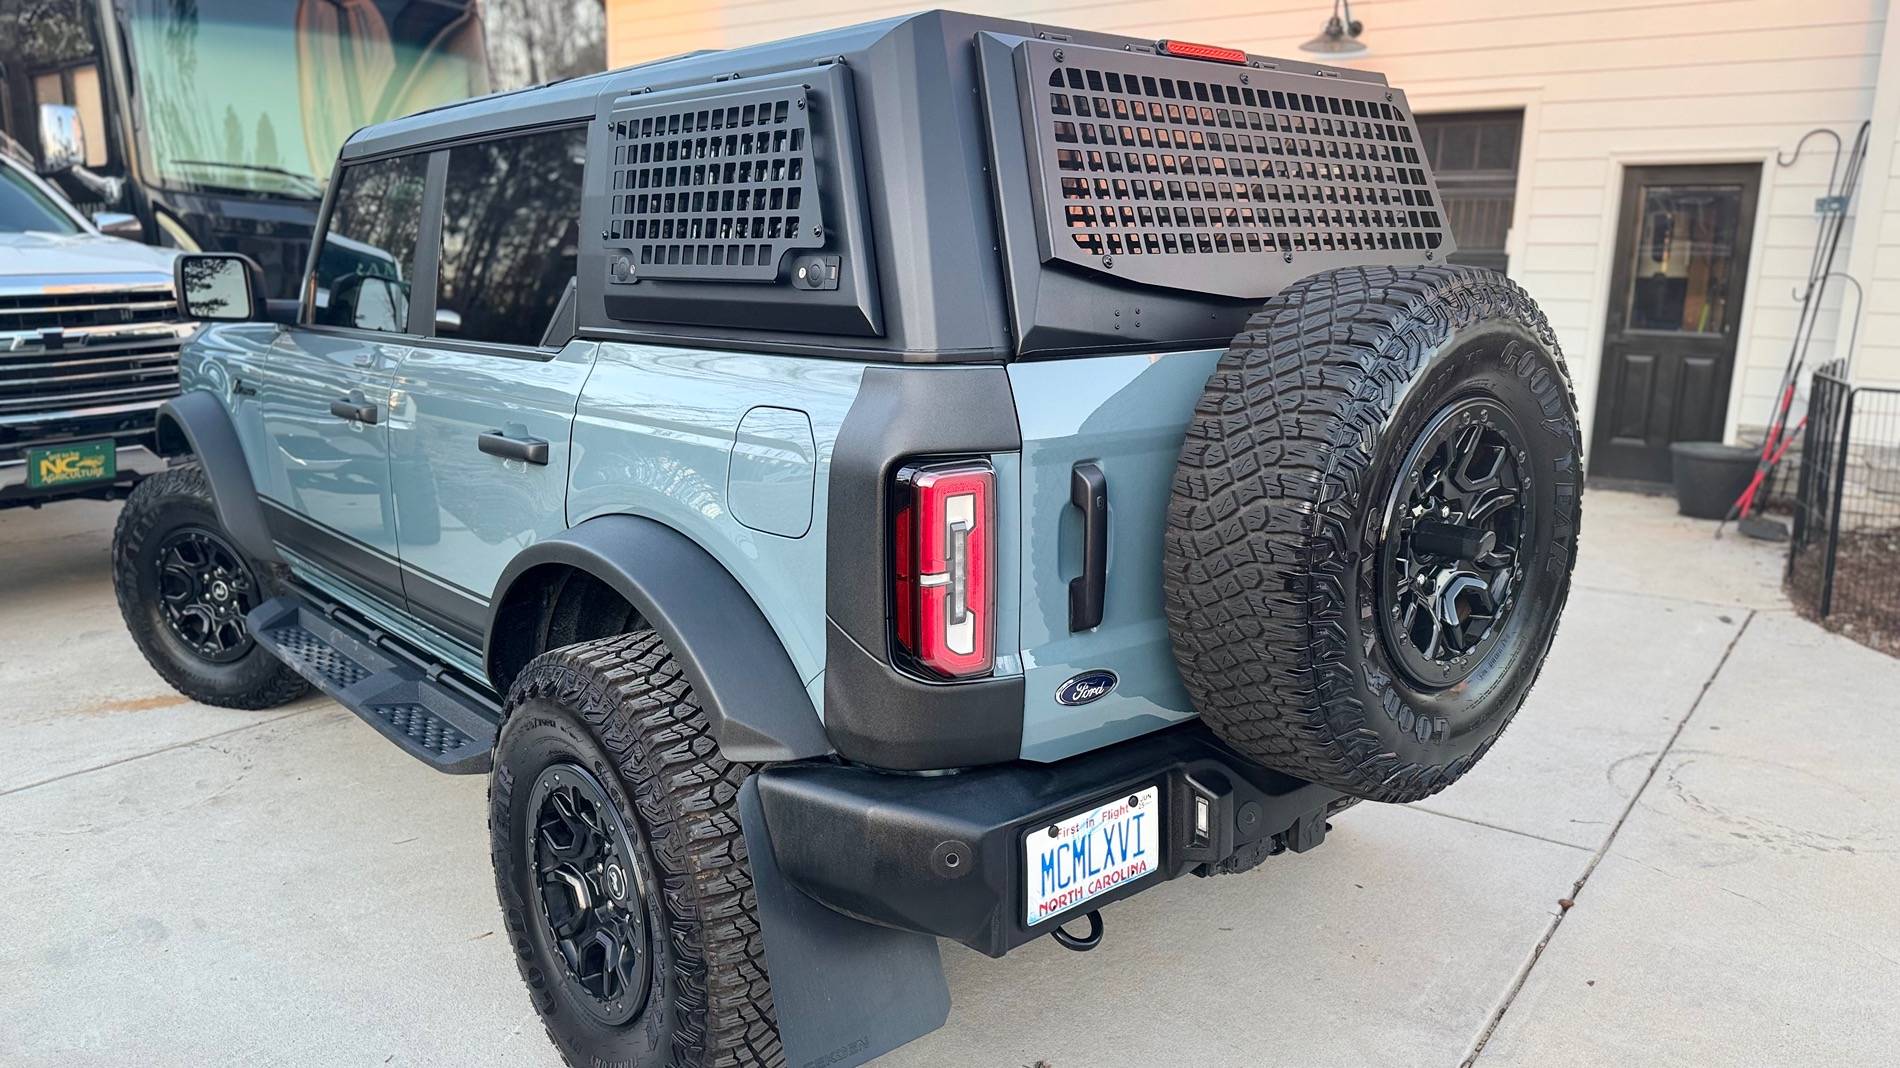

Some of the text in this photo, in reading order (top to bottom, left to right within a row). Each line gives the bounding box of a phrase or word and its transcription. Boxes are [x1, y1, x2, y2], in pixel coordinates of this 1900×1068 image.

[40, 456, 80, 476] NC
[1072, 681, 1106, 701] Ford
[1057, 804, 1130, 838] First in Flight
[1041, 812, 1146, 898] MCMLXVI
[1039, 860, 1147, 917] NORTH CAROLINA
